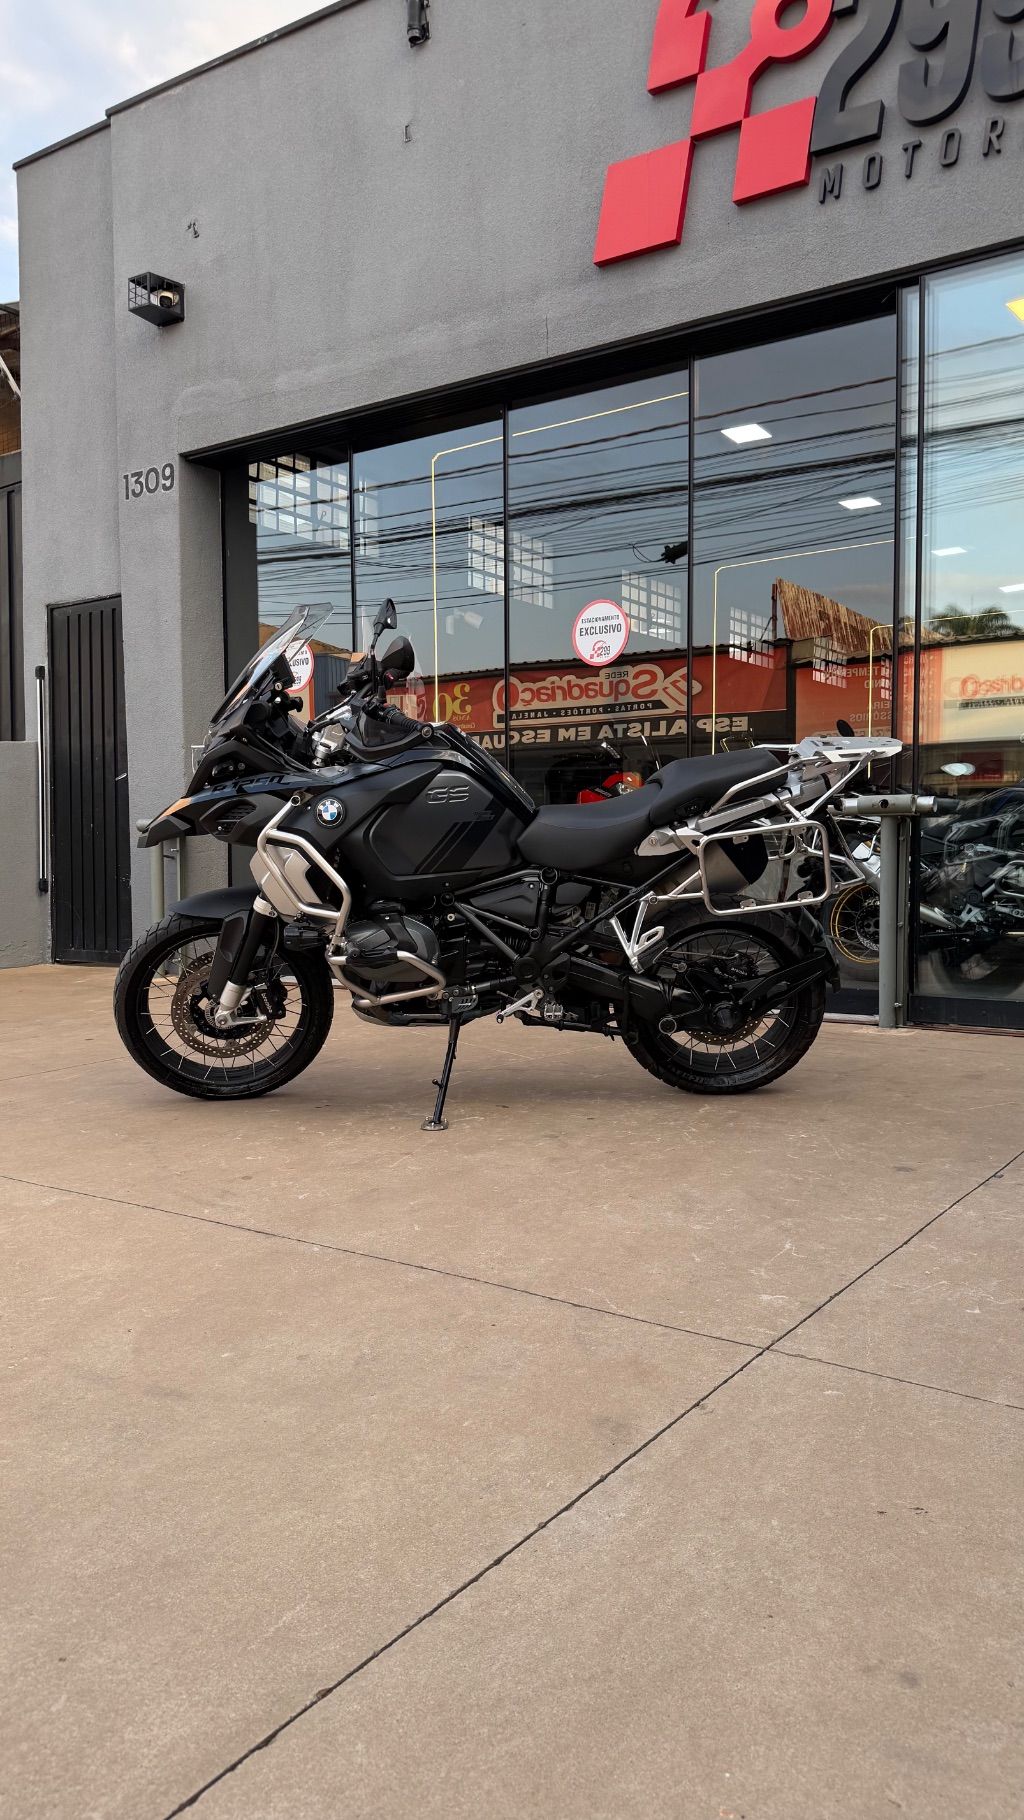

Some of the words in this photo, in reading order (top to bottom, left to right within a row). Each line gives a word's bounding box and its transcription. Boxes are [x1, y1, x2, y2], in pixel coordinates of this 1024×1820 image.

[123, 463, 175, 500] 1309
[579, 623, 622, 637] EXCLUSIVO
[425, 785, 470, 804] GS
[317, 799, 341, 811] BMW
